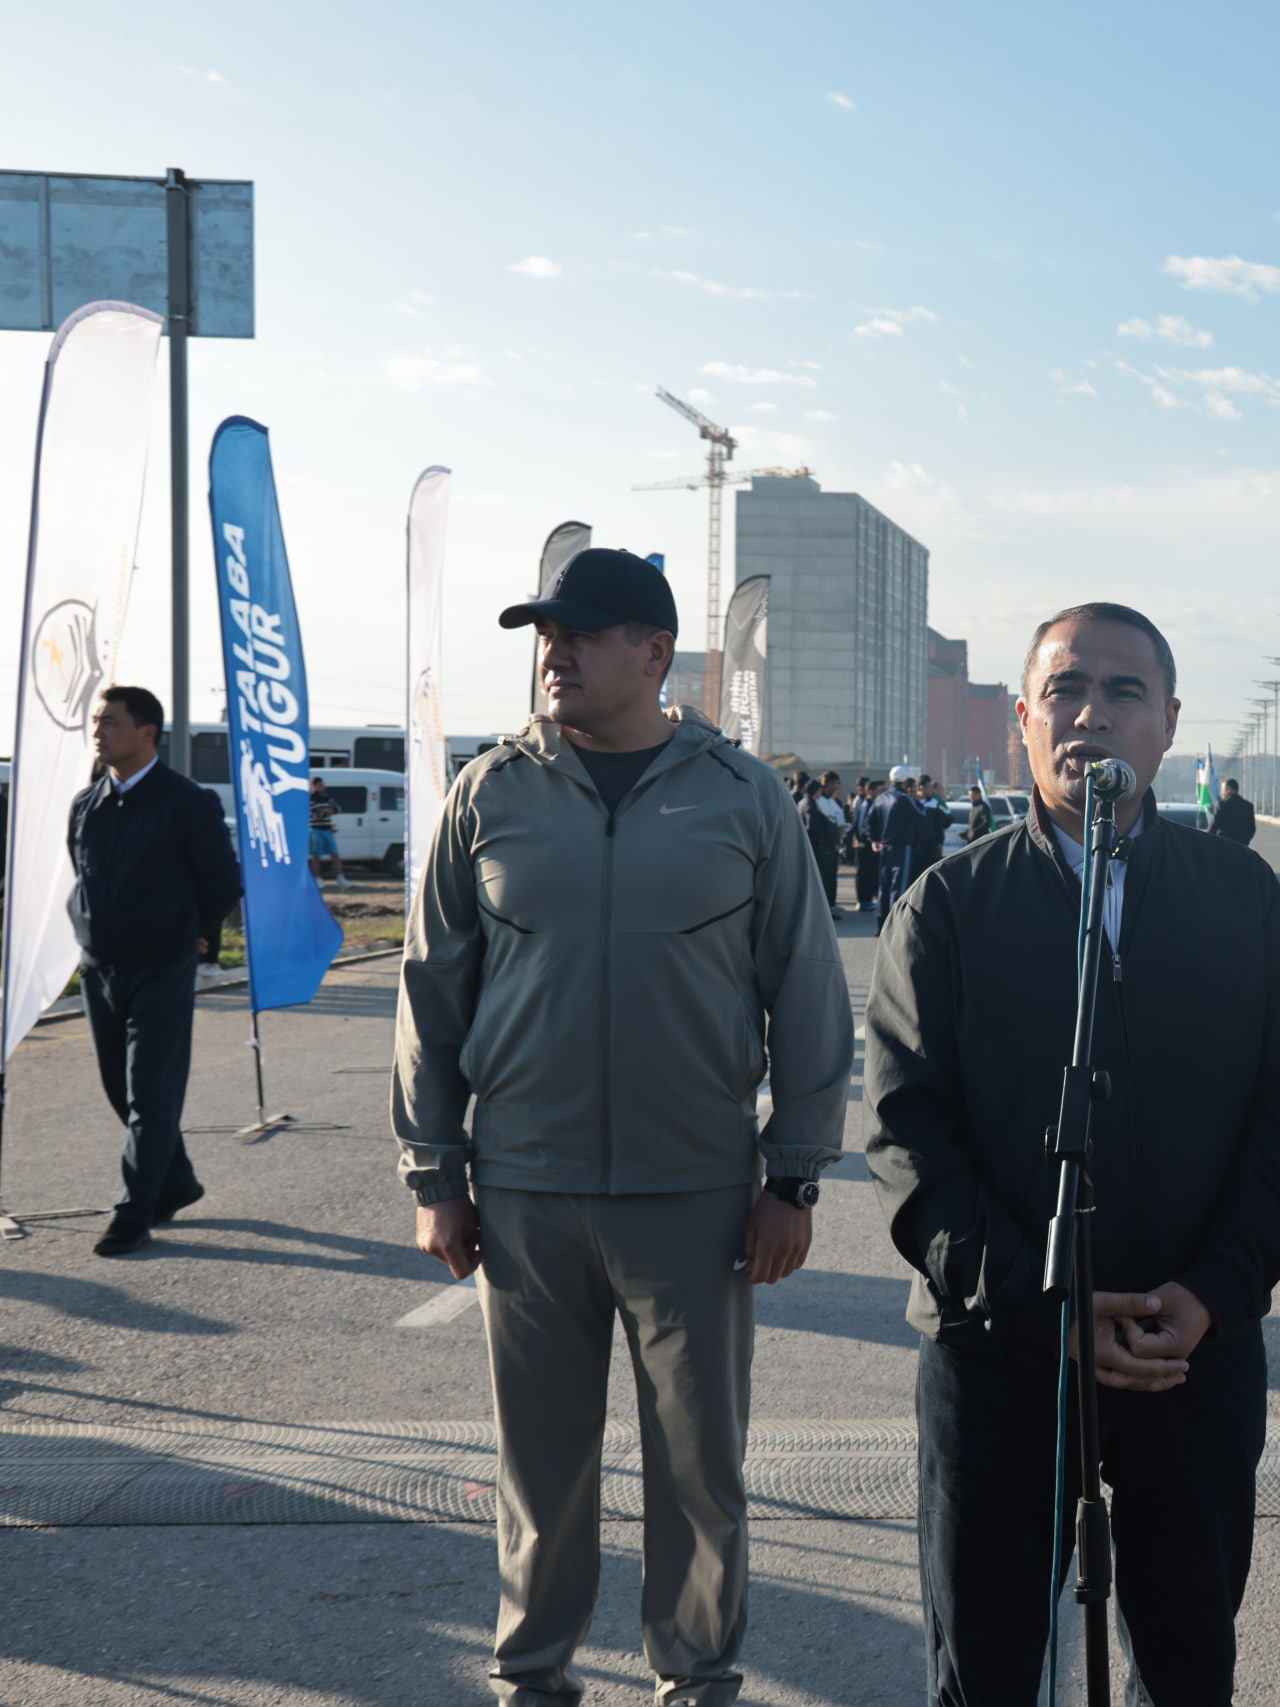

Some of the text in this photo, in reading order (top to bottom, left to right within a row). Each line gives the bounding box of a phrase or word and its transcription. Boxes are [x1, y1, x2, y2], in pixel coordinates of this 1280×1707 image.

[223, 522, 260, 733] TALABA
[250, 603, 310, 797] YUGUR
[740, 717, 753, 750] SILK
